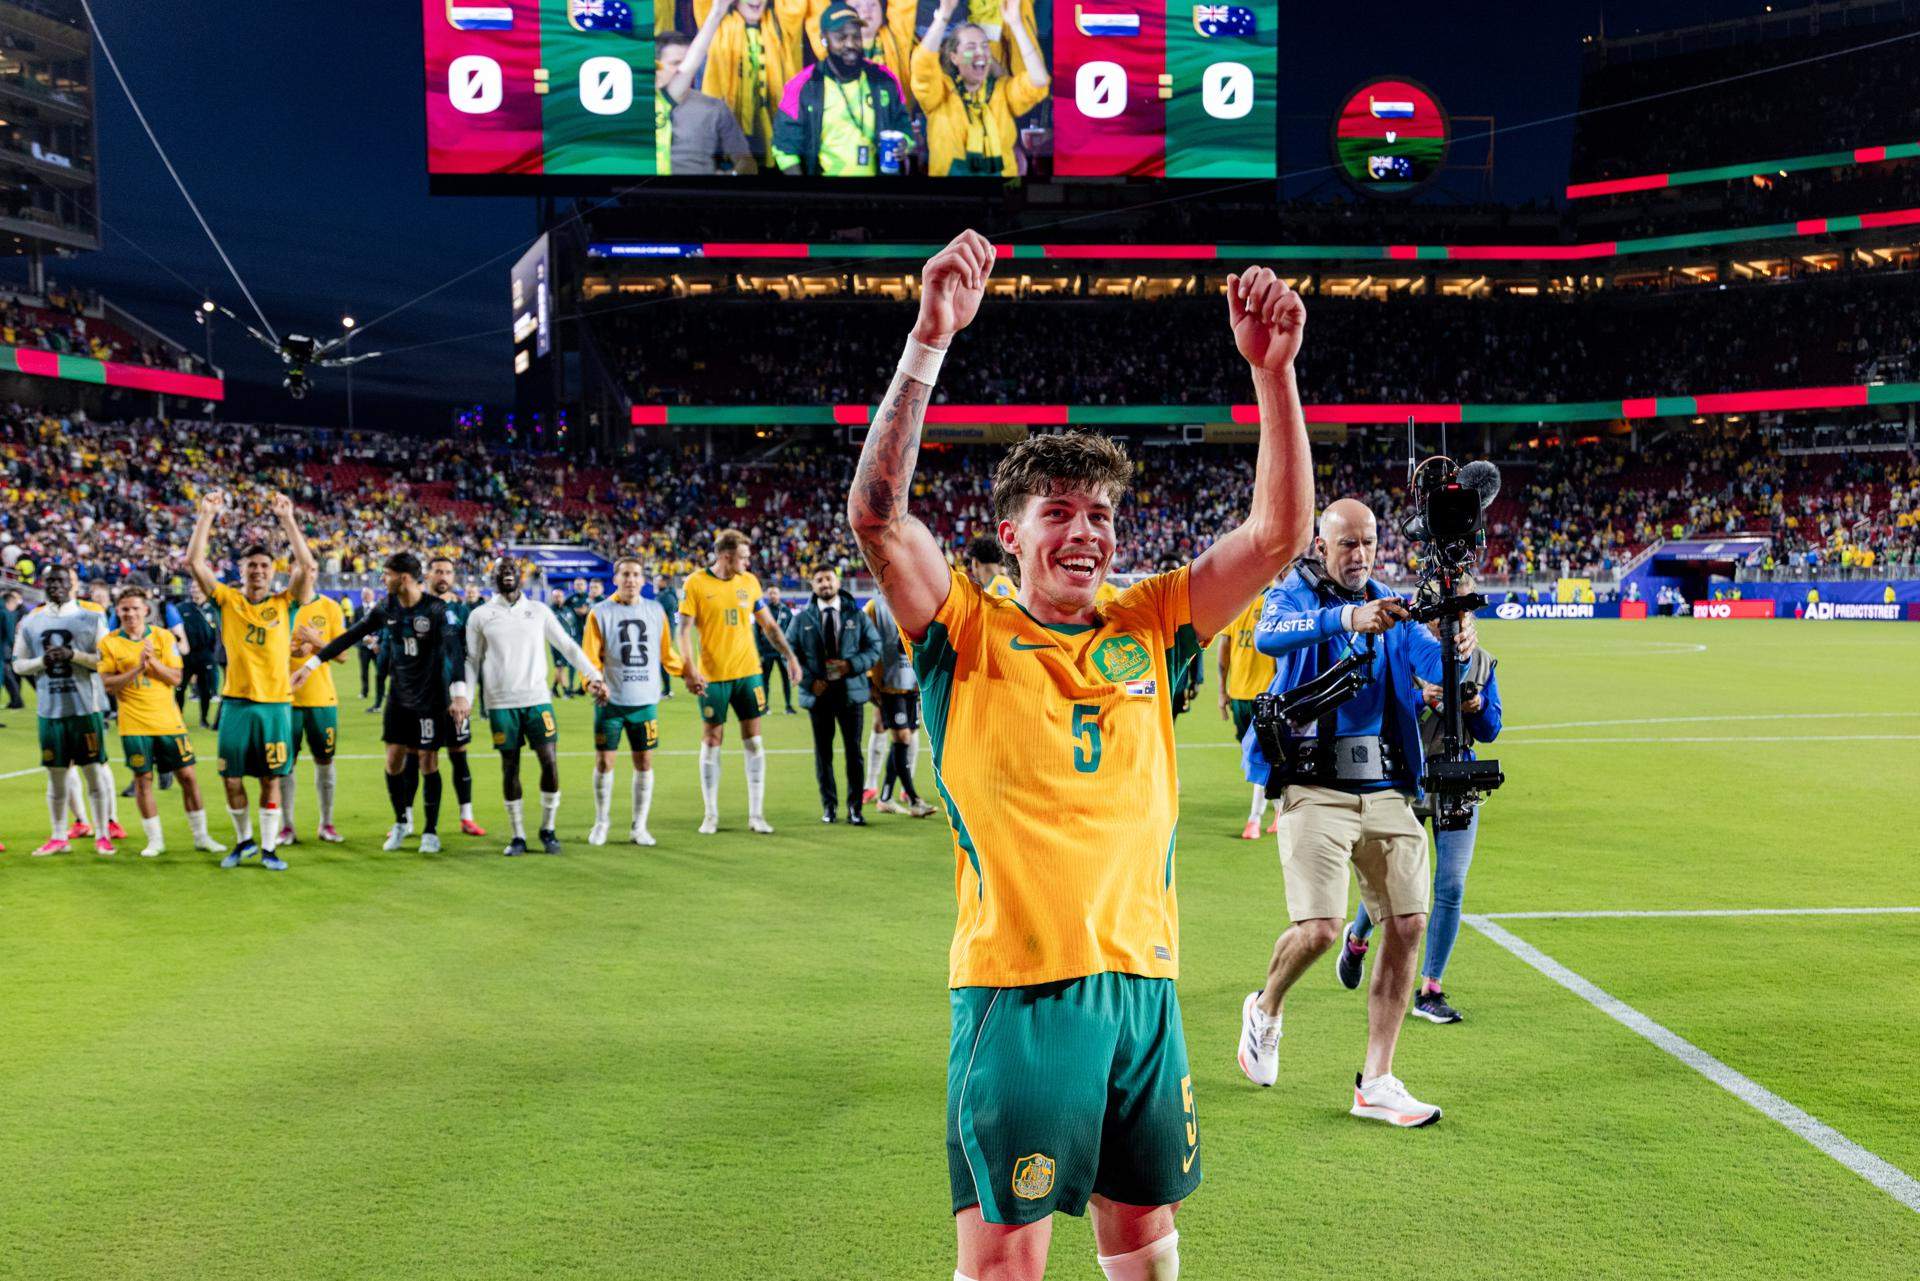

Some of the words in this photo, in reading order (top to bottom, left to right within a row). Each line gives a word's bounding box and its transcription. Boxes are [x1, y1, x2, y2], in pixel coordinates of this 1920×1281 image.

[448, 55, 502, 113] 0
[579, 56, 632, 115] 0
[1076, 61, 1127, 118] 0
[1203, 62, 1254, 119] 0
[725, 608, 738, 626] 19
[1526, 604, 1594, 618] HYUNDAI
[245, 623, 266, 645] 20
[1239, 629, 1252, 648] 22
[402, 637, 418, 656] 18
[325, 727, 335, 746] 3
[419, 718, 434, 739] 18
[1072, 704, 1102, 773] 5
[265, 741, 288, 763] 20
[1181, 1074, 1197, 1147] 5
